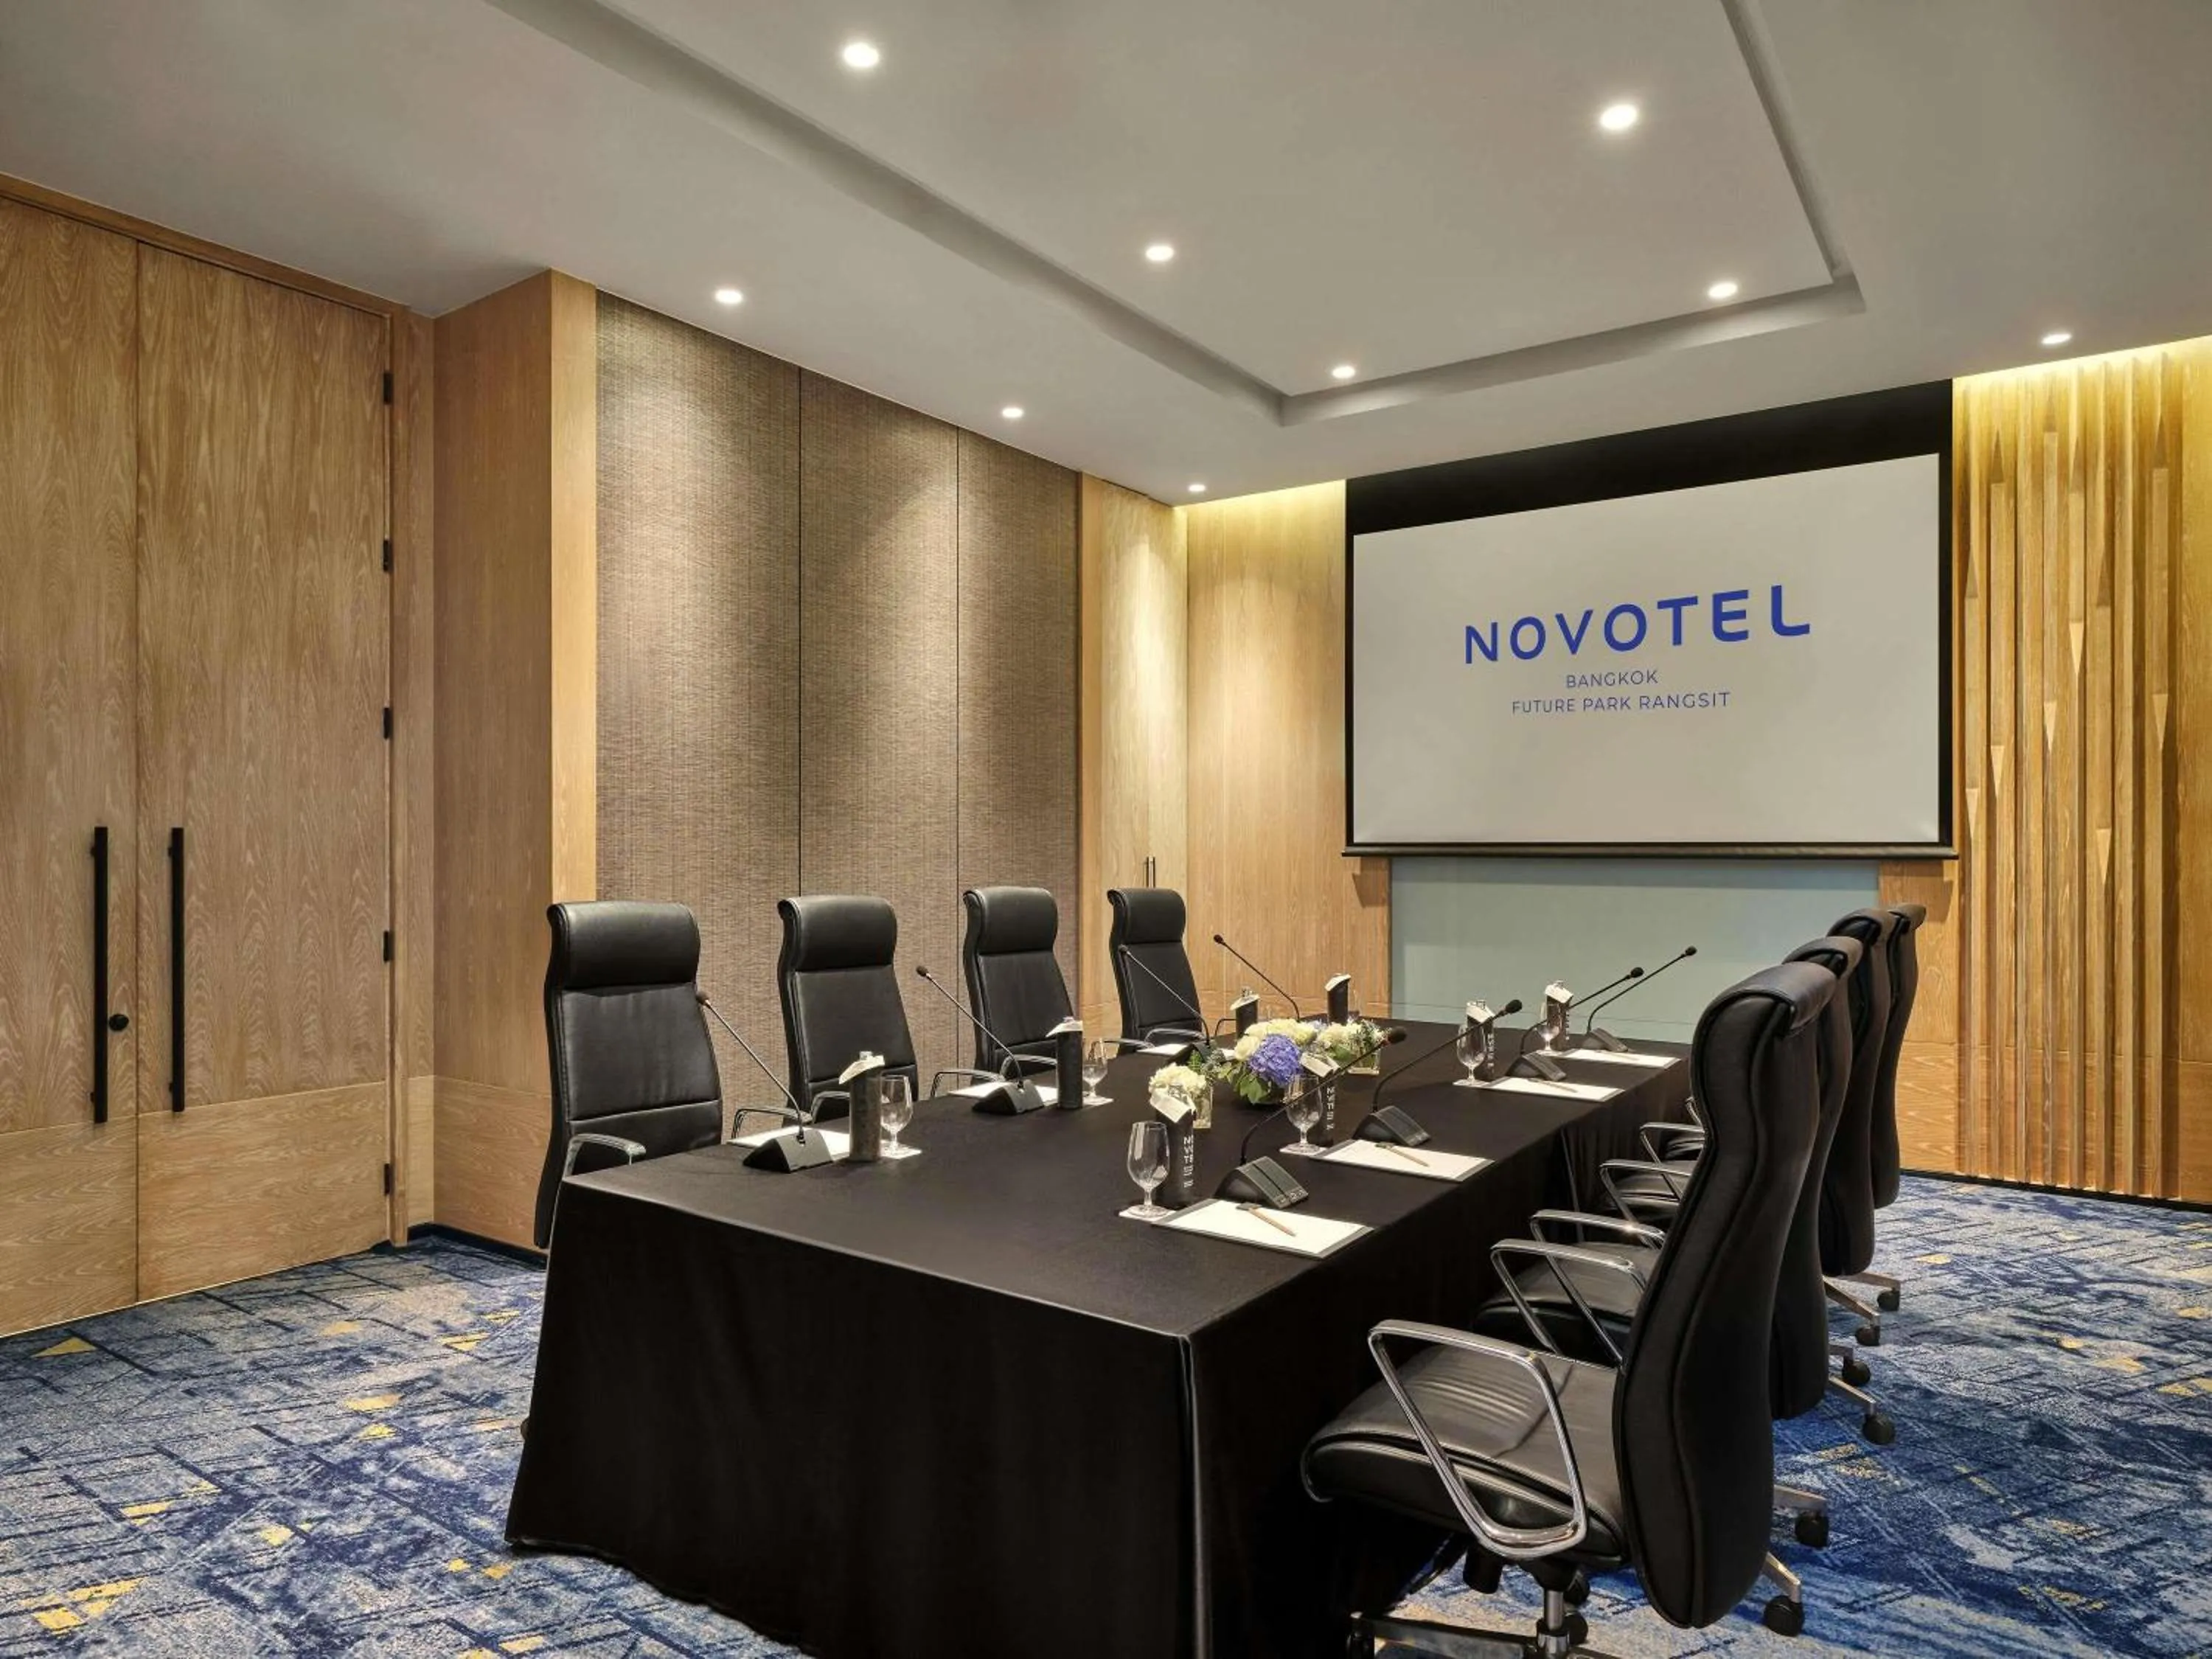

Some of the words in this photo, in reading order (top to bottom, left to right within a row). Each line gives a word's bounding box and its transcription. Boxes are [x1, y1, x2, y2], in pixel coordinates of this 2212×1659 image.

[1464, 584, 1811, 664] NOVOTEL
[1566, 669, 1658, 689] BANGKOK
[1512, 698, 1576, 714] FUTURE
[1582, 696, 1632, 712] PARK
[1638, 691, 1731, 710] RANGSIT
